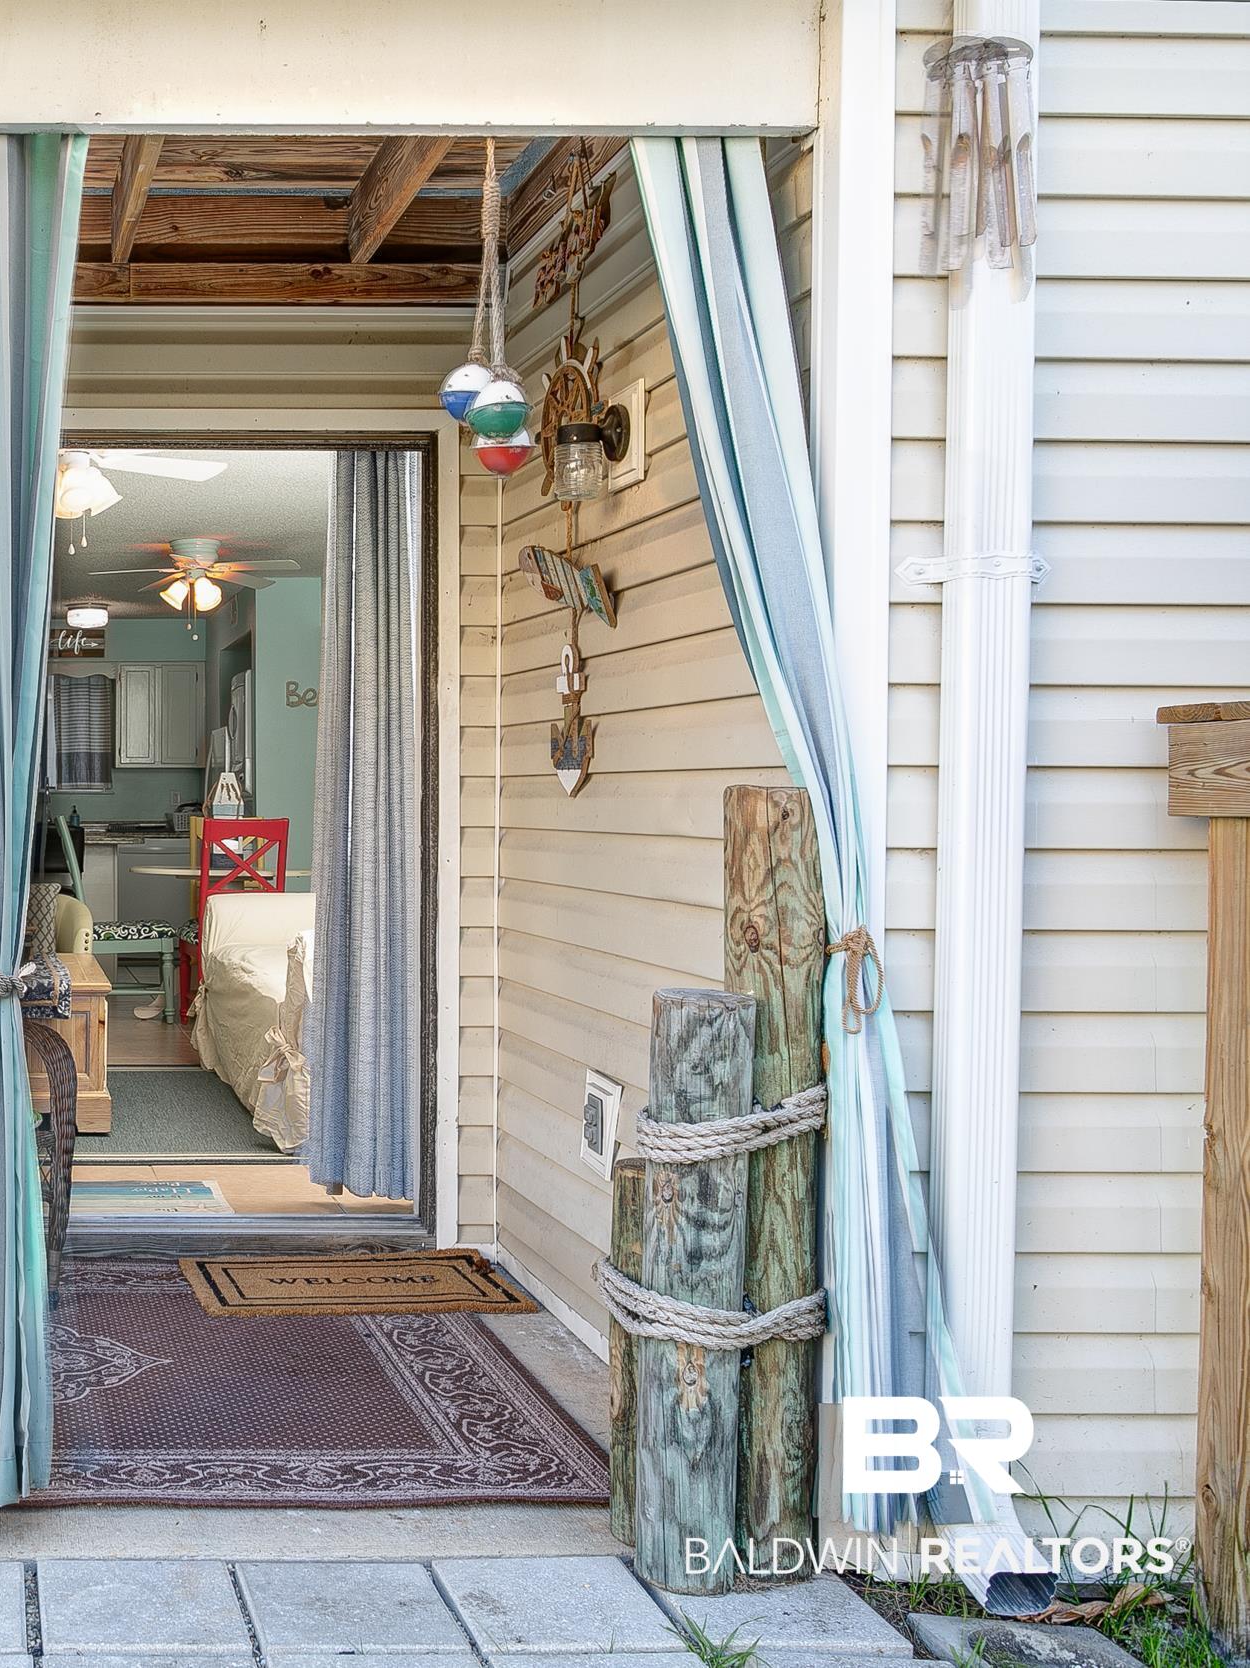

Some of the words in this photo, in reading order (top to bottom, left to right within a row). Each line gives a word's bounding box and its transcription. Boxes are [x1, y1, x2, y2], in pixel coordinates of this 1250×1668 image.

[57, 629, 88, 655] life
[286, 680, 319, 708] Be
[266, 1275, 440, 1285] WELCOME
